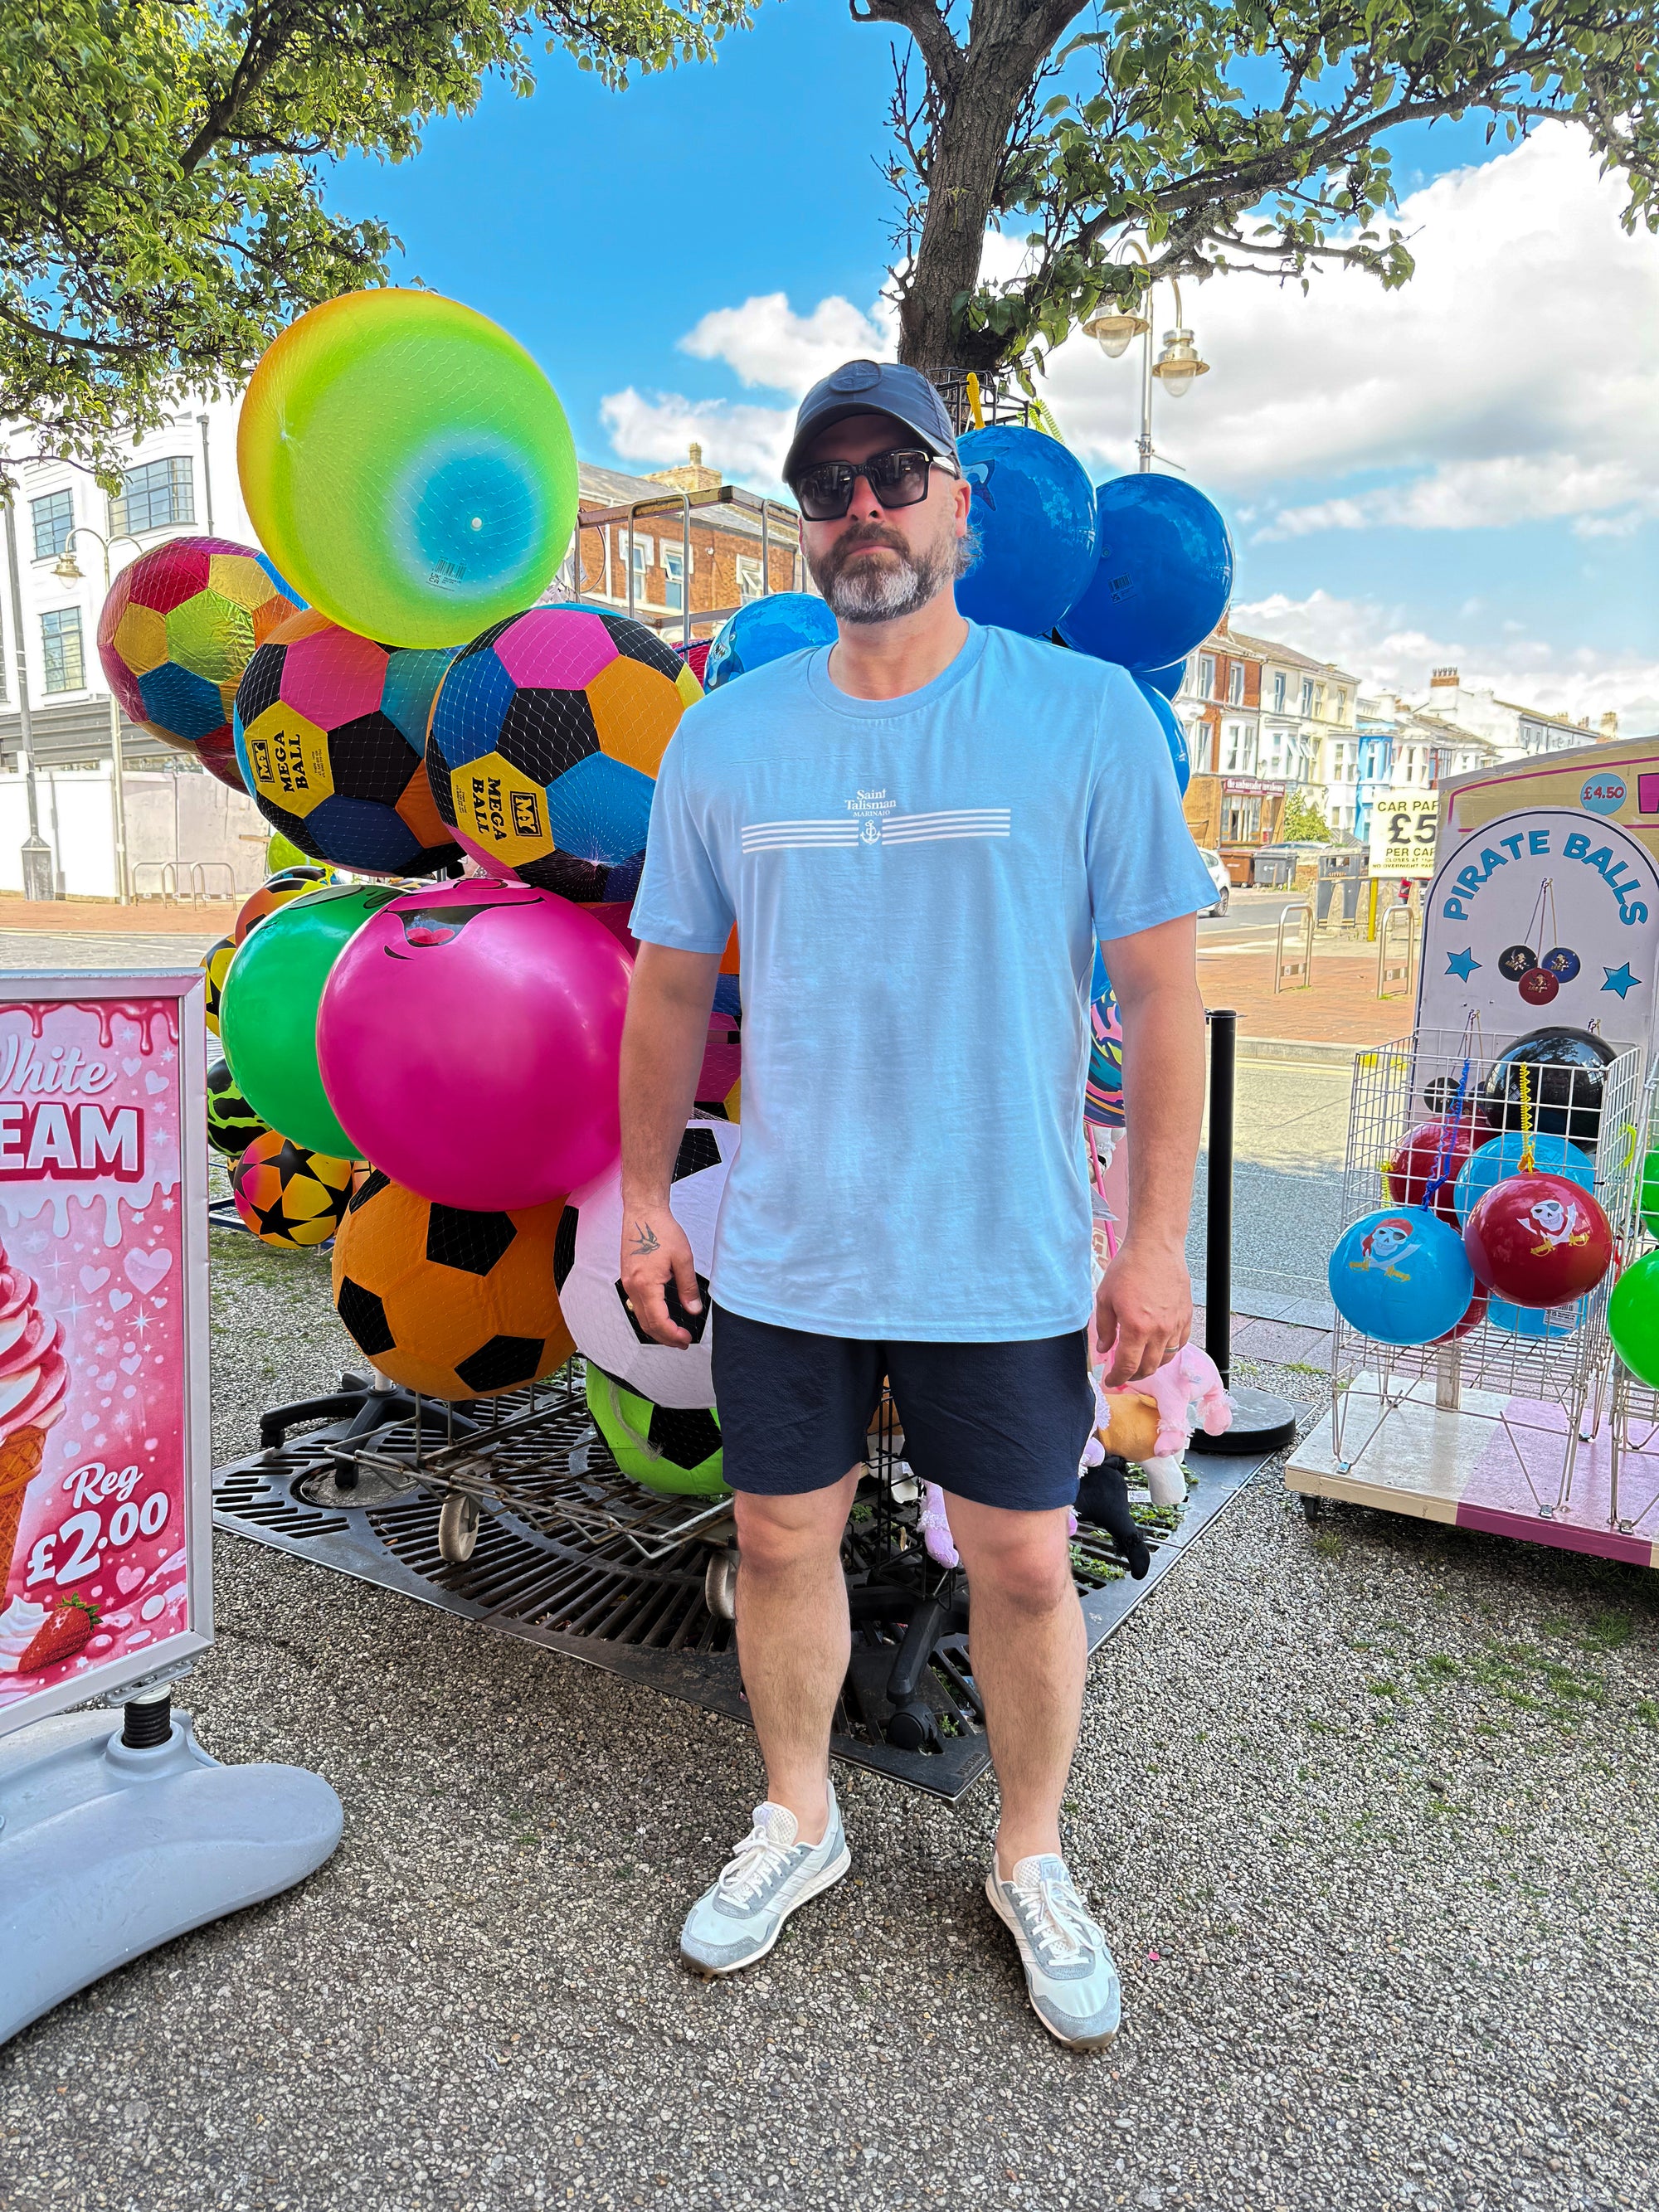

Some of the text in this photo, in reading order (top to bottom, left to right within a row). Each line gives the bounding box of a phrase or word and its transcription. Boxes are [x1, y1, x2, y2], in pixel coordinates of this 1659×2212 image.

[273, 730, 294, 793] MEGA
[289, 734, 309, 790] BALL
[472, 777, 489, 834] BALL
[488, 776, 507, 841] MEGA
[844, 800, 896, 810] Talisman
[856, 788, 887, 800] Saint
[1378, 801, 1407, 811] CAR
[1584, 785, 1624, 800] £4.50
[1386, 848, 1408, 856] PER
[1388, 814, 1437, 843] £5
[1443, 830, 1648, 926] PIRATE BALLS
[62, 1462, 144, 1509] Reg
[27, 1492, 168, 1587] £2.00
